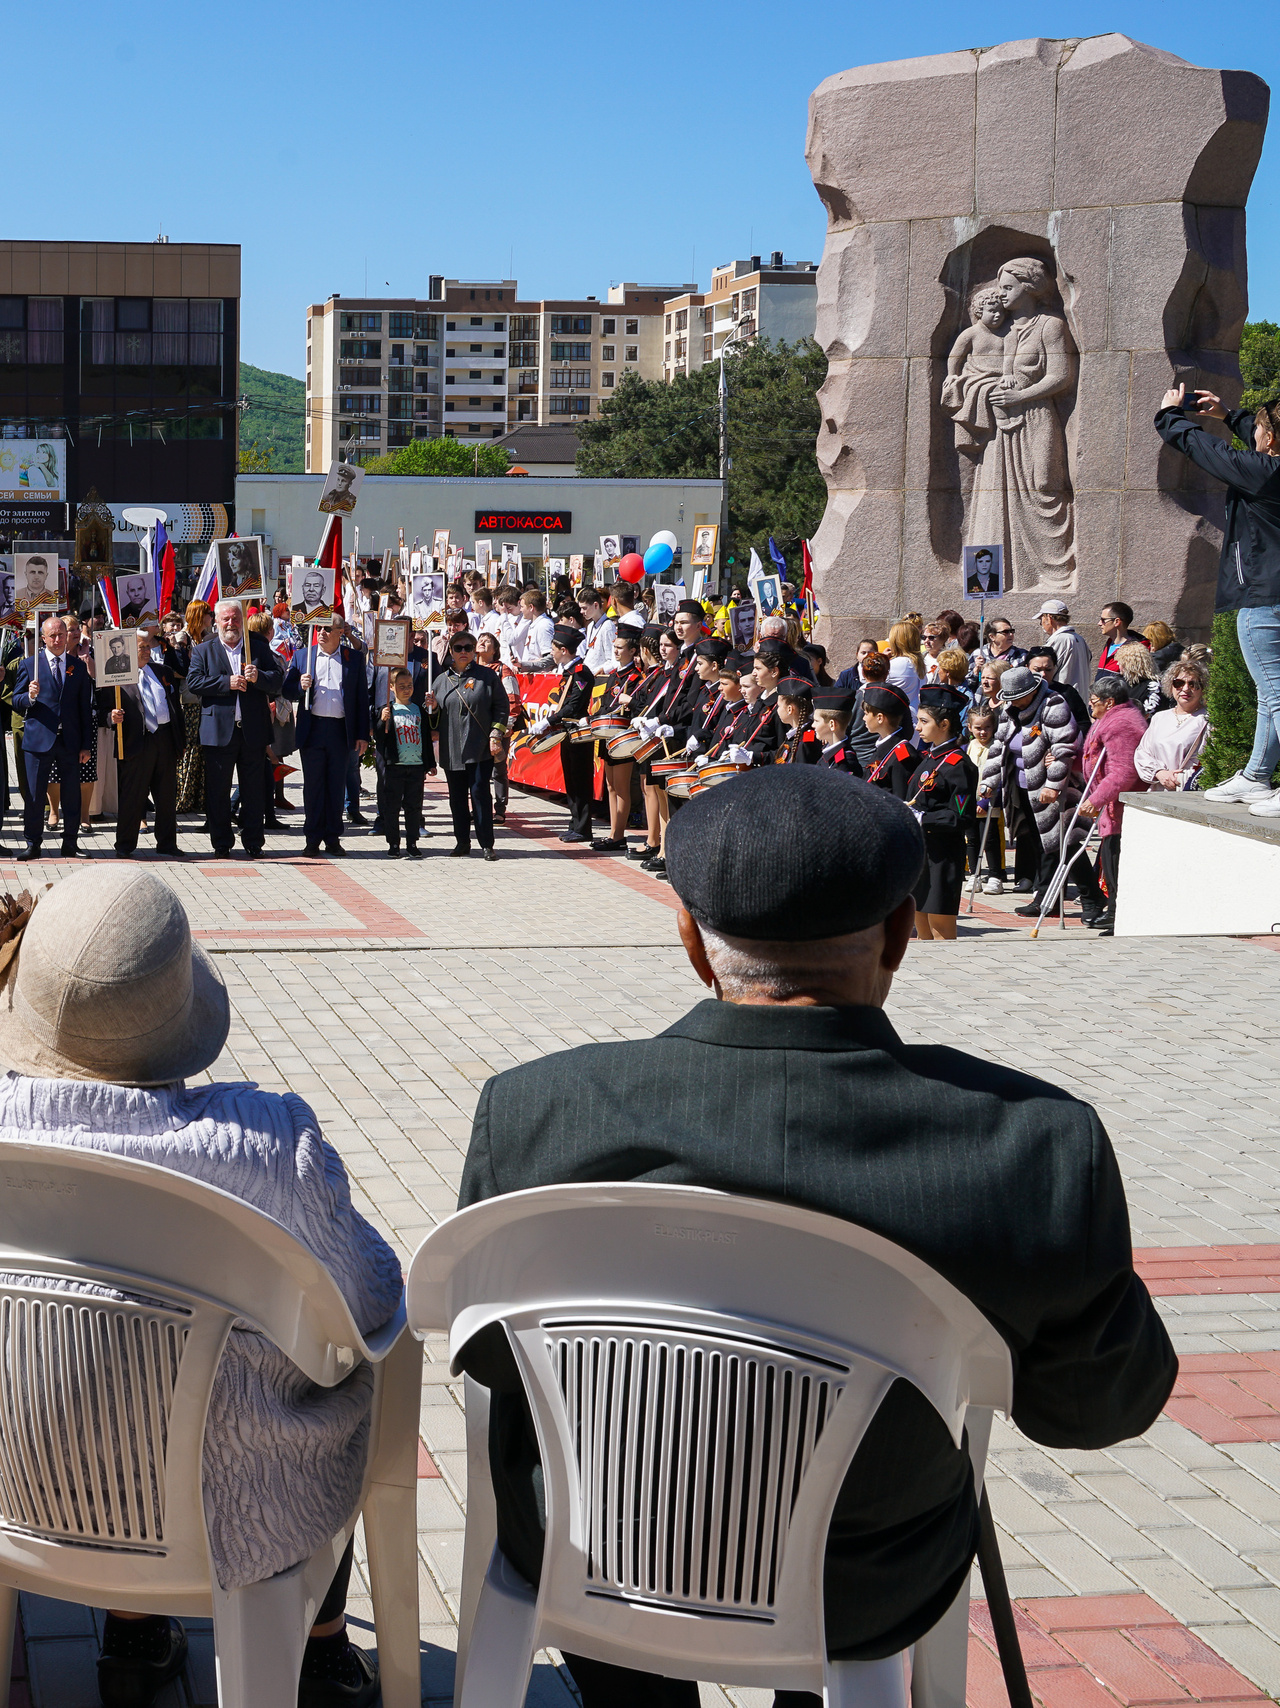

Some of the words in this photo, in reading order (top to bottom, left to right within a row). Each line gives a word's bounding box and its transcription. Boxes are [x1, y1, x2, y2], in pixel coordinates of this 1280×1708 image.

[23, 492, 52, 500] СЕМЬИ
[0, 509, 12, 517] От
[13, 509, 51, 517] элитного
[0, 517, 10, 525] до
[11, 517, 46, 526] простого
[478, 516, 563, 529] АВТОКАССА
[397, 724, 421, 745] FREE
[654, 1223, 739, 1245] ELLASTIK-PLAST
